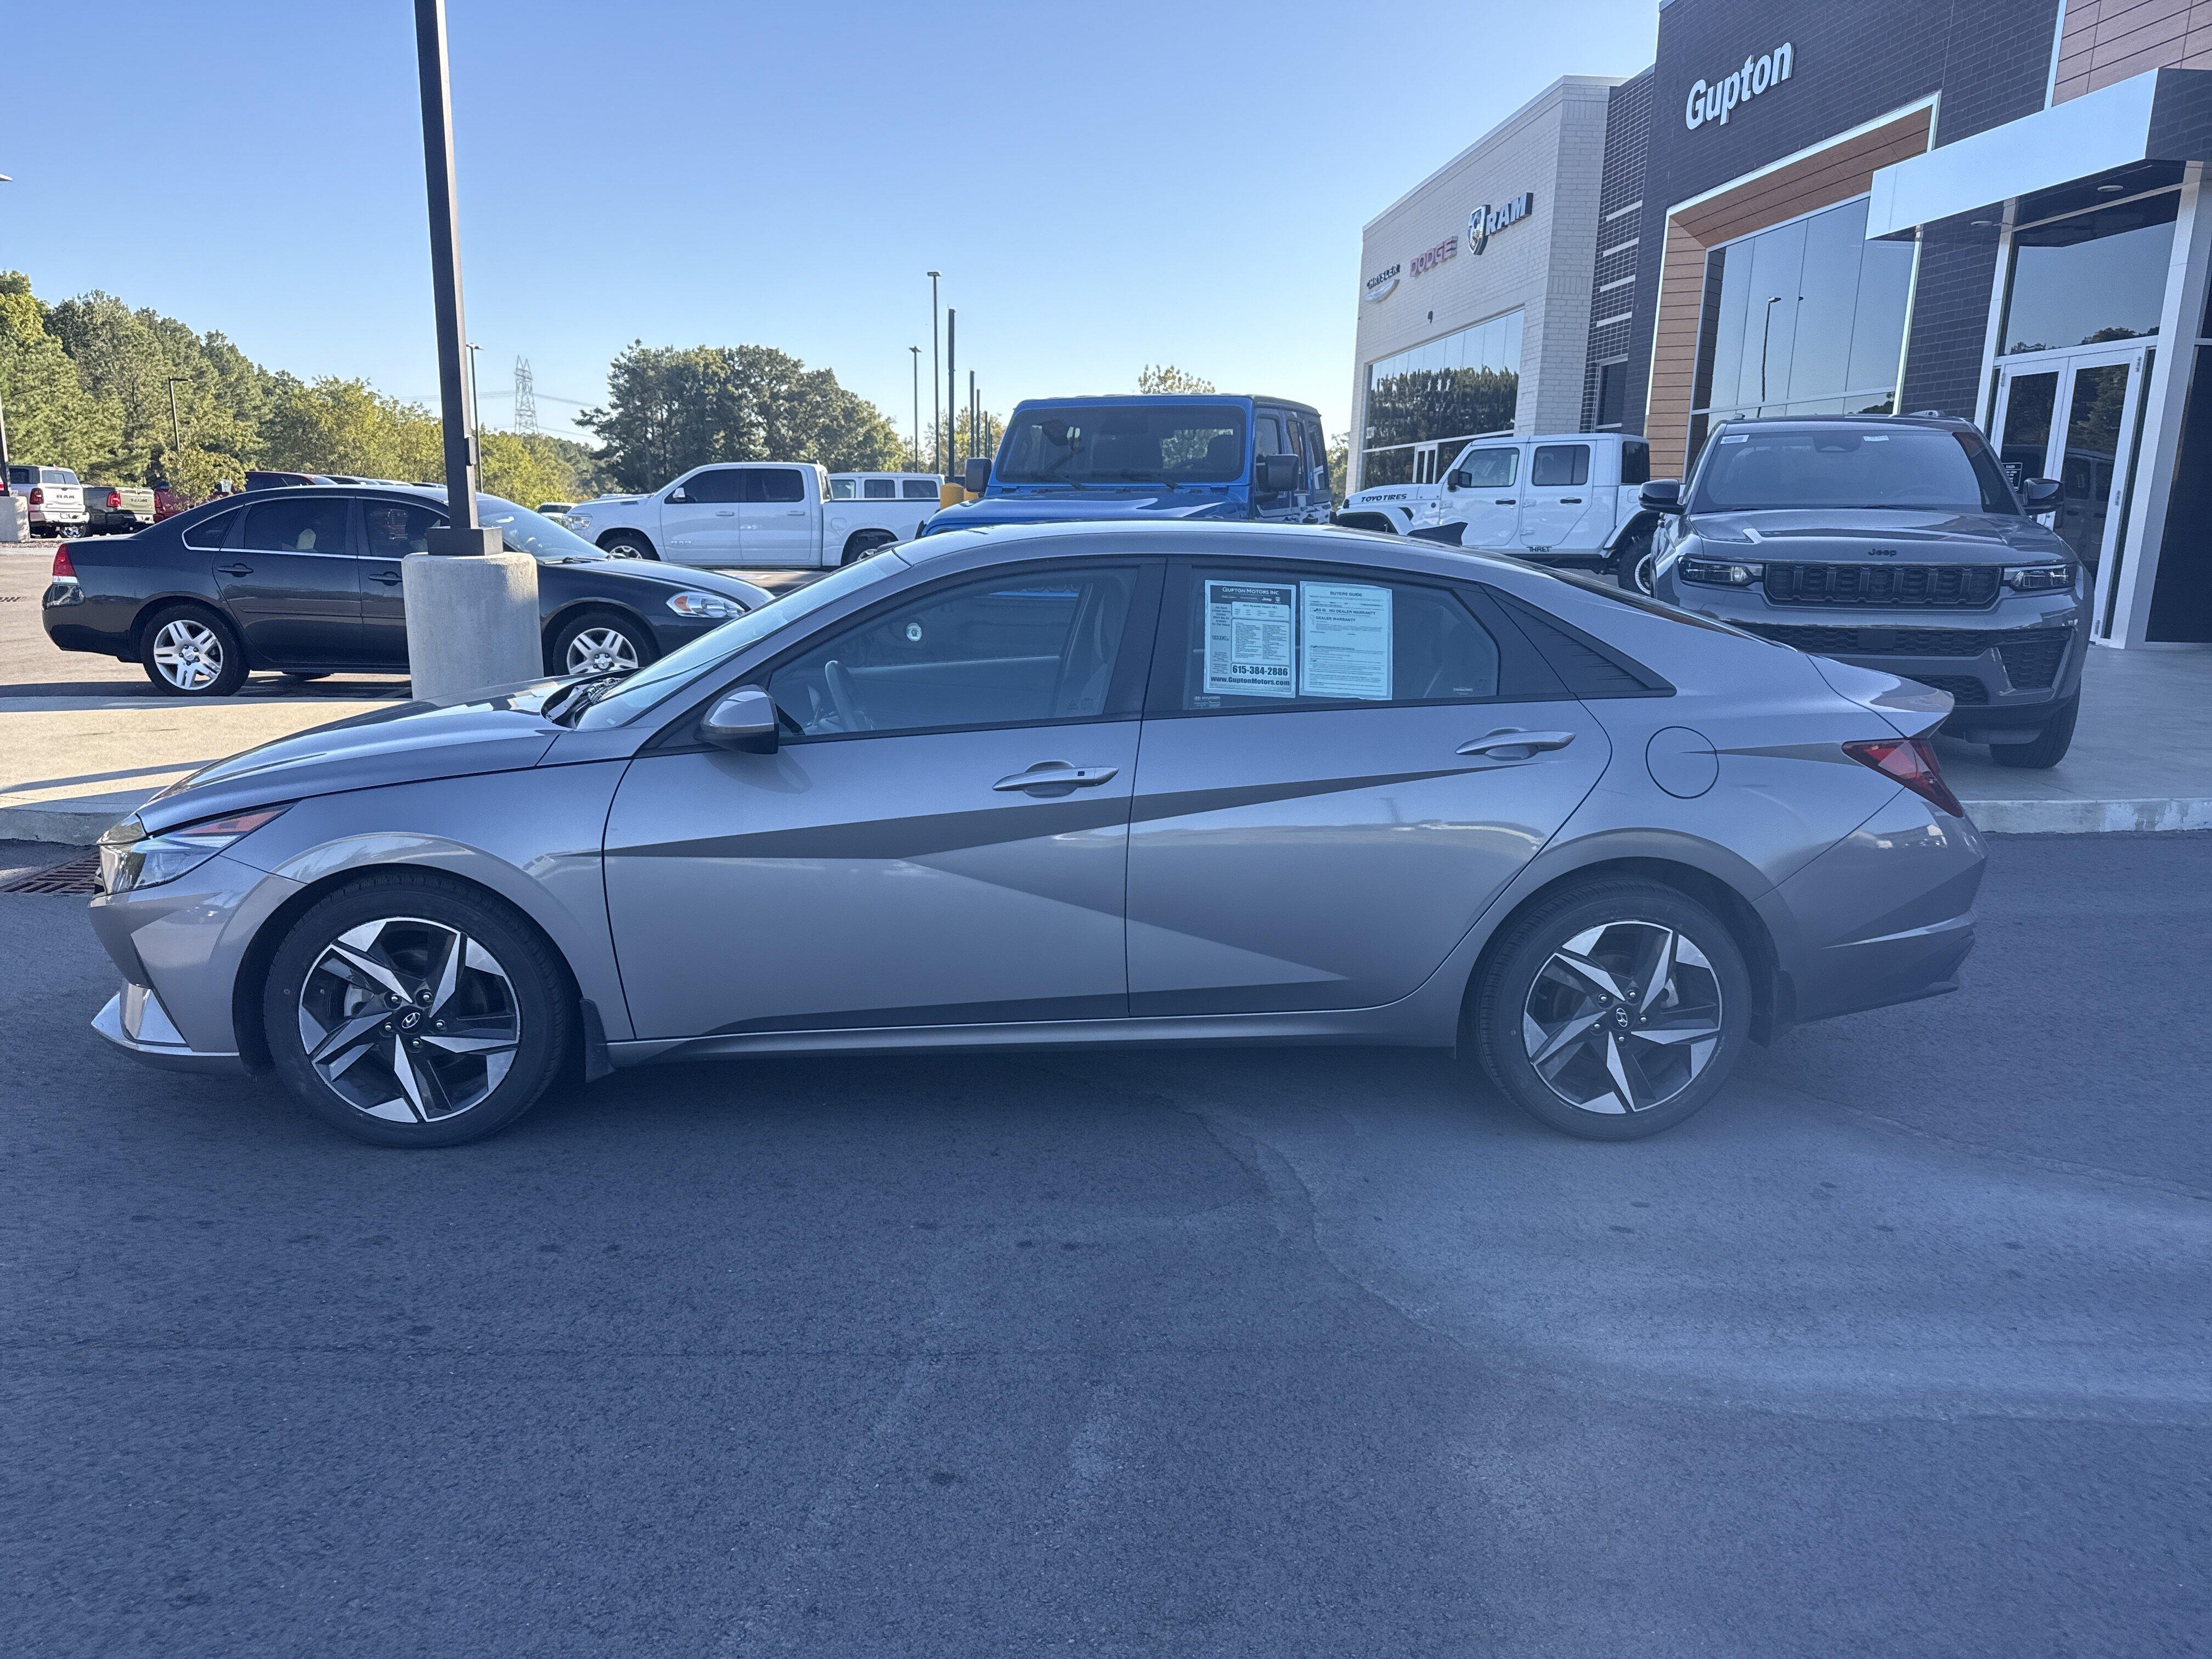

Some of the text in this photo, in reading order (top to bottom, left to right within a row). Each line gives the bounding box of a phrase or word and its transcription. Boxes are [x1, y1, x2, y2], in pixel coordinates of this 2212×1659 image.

[1685, 42, 1794, 130] Gupton
[1485, 192, 1533, 236] RAM
[1410, 236, 1458, 277] DODGE
[1868, 549, 1897, 557] Jeep
[1211, 676, 1290, 686] www.GuptonMotors.com
[1232, 665, 1288, 676] 615-384-2886
